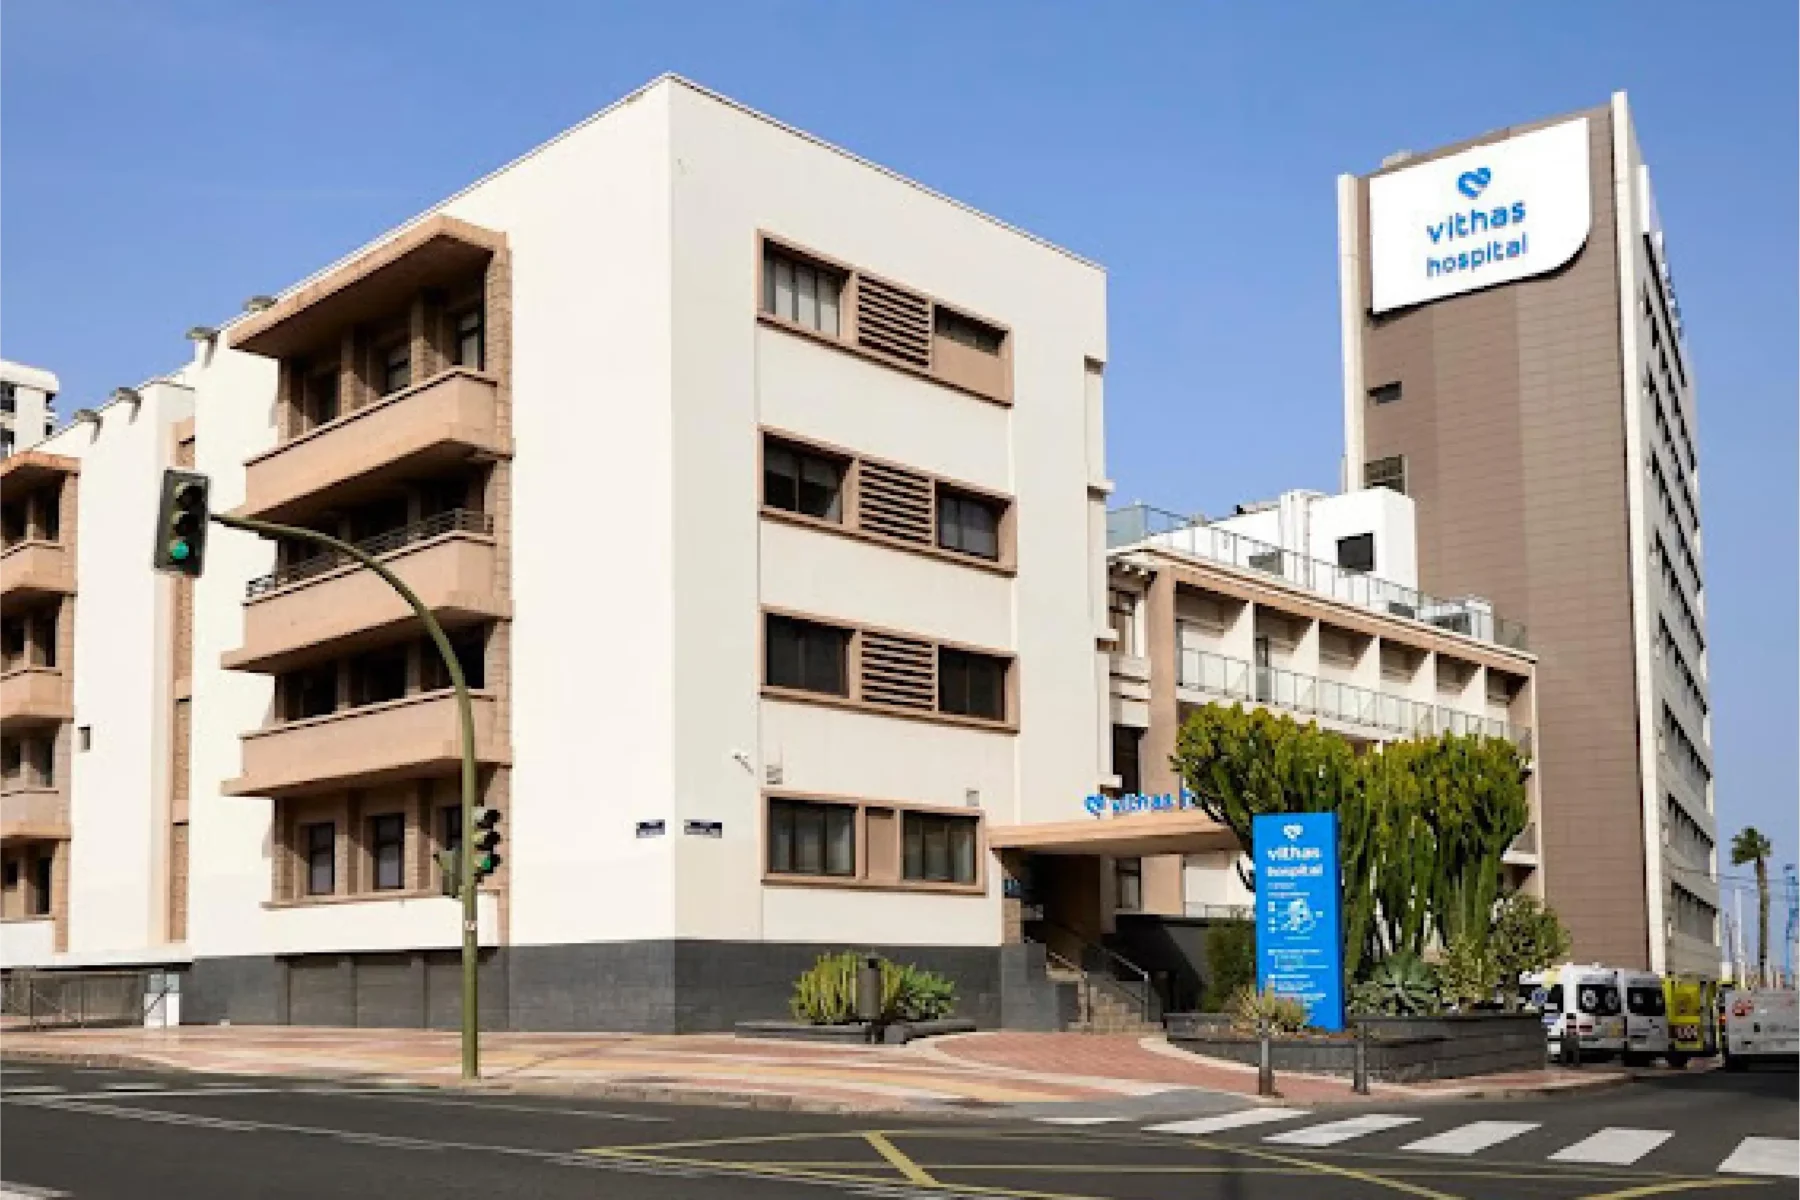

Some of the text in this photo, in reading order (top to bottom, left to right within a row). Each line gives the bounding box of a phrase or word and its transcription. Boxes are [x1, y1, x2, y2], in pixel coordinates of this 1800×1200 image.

[1426, 201, 1526, 245] vithas
[1426, 232, 1529, 278] hospital
[1267, 845, 1322, 861] vithas
[1267, 864, 1323, 880] hospital
